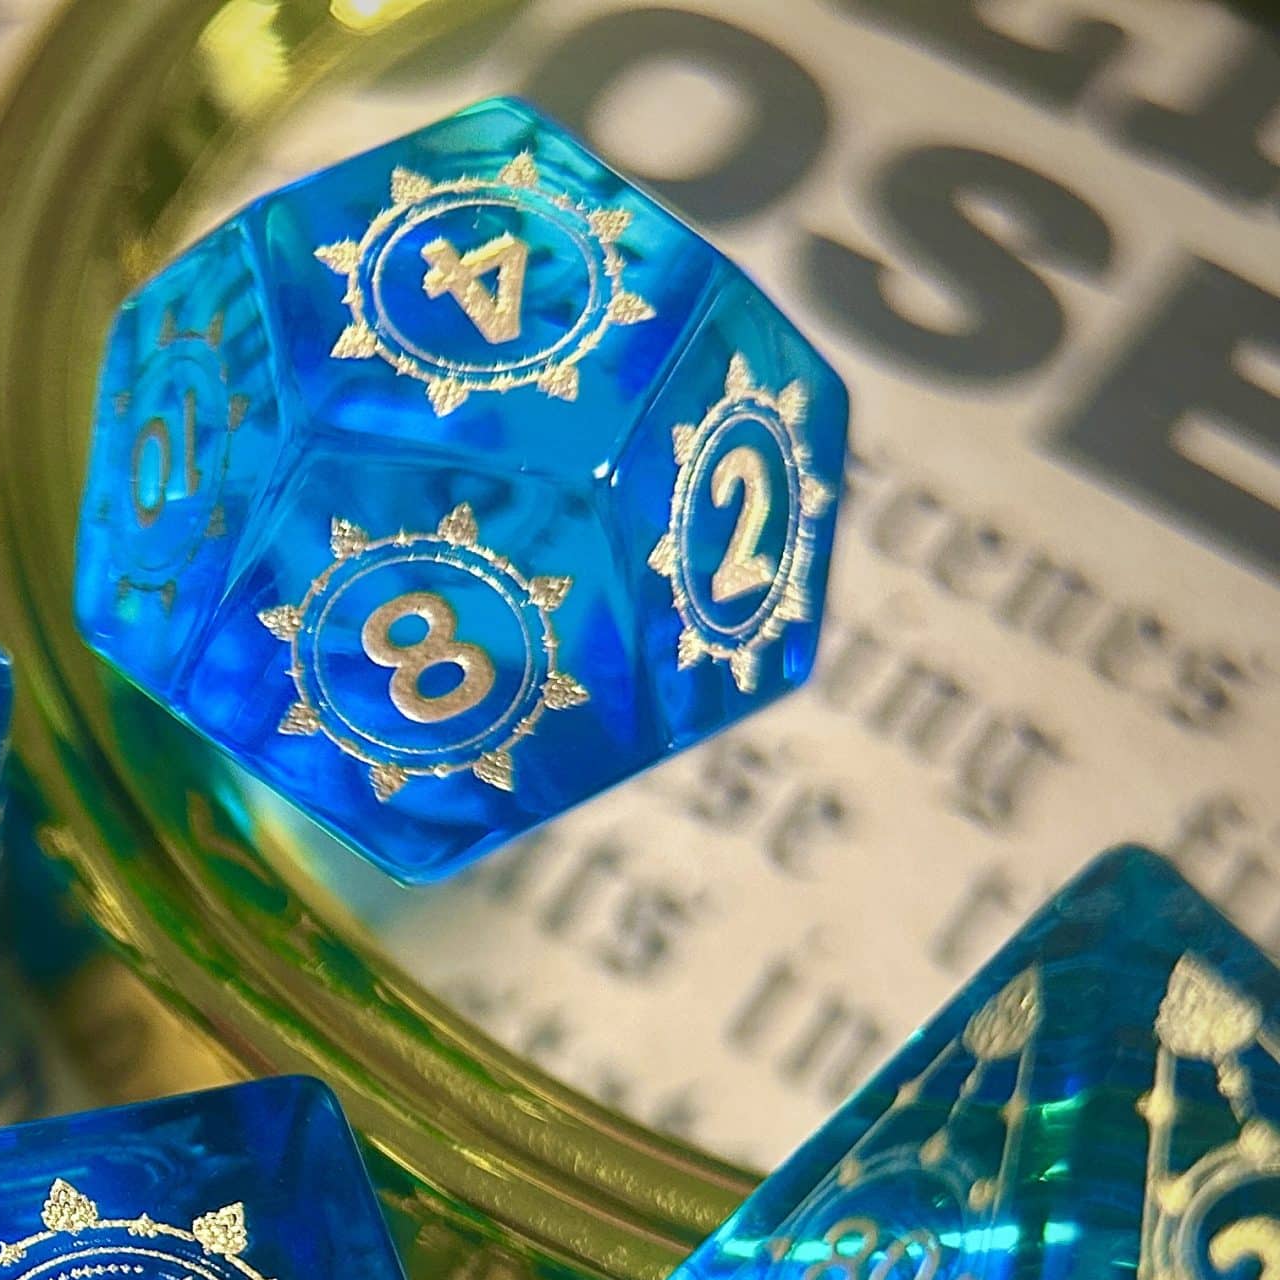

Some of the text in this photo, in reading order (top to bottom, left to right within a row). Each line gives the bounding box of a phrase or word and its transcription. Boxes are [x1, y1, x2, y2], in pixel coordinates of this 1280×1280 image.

[422, 231, 528, 345] 4
[710, 446, 776, 604] 2
[361, 589, 496, 725] 8
